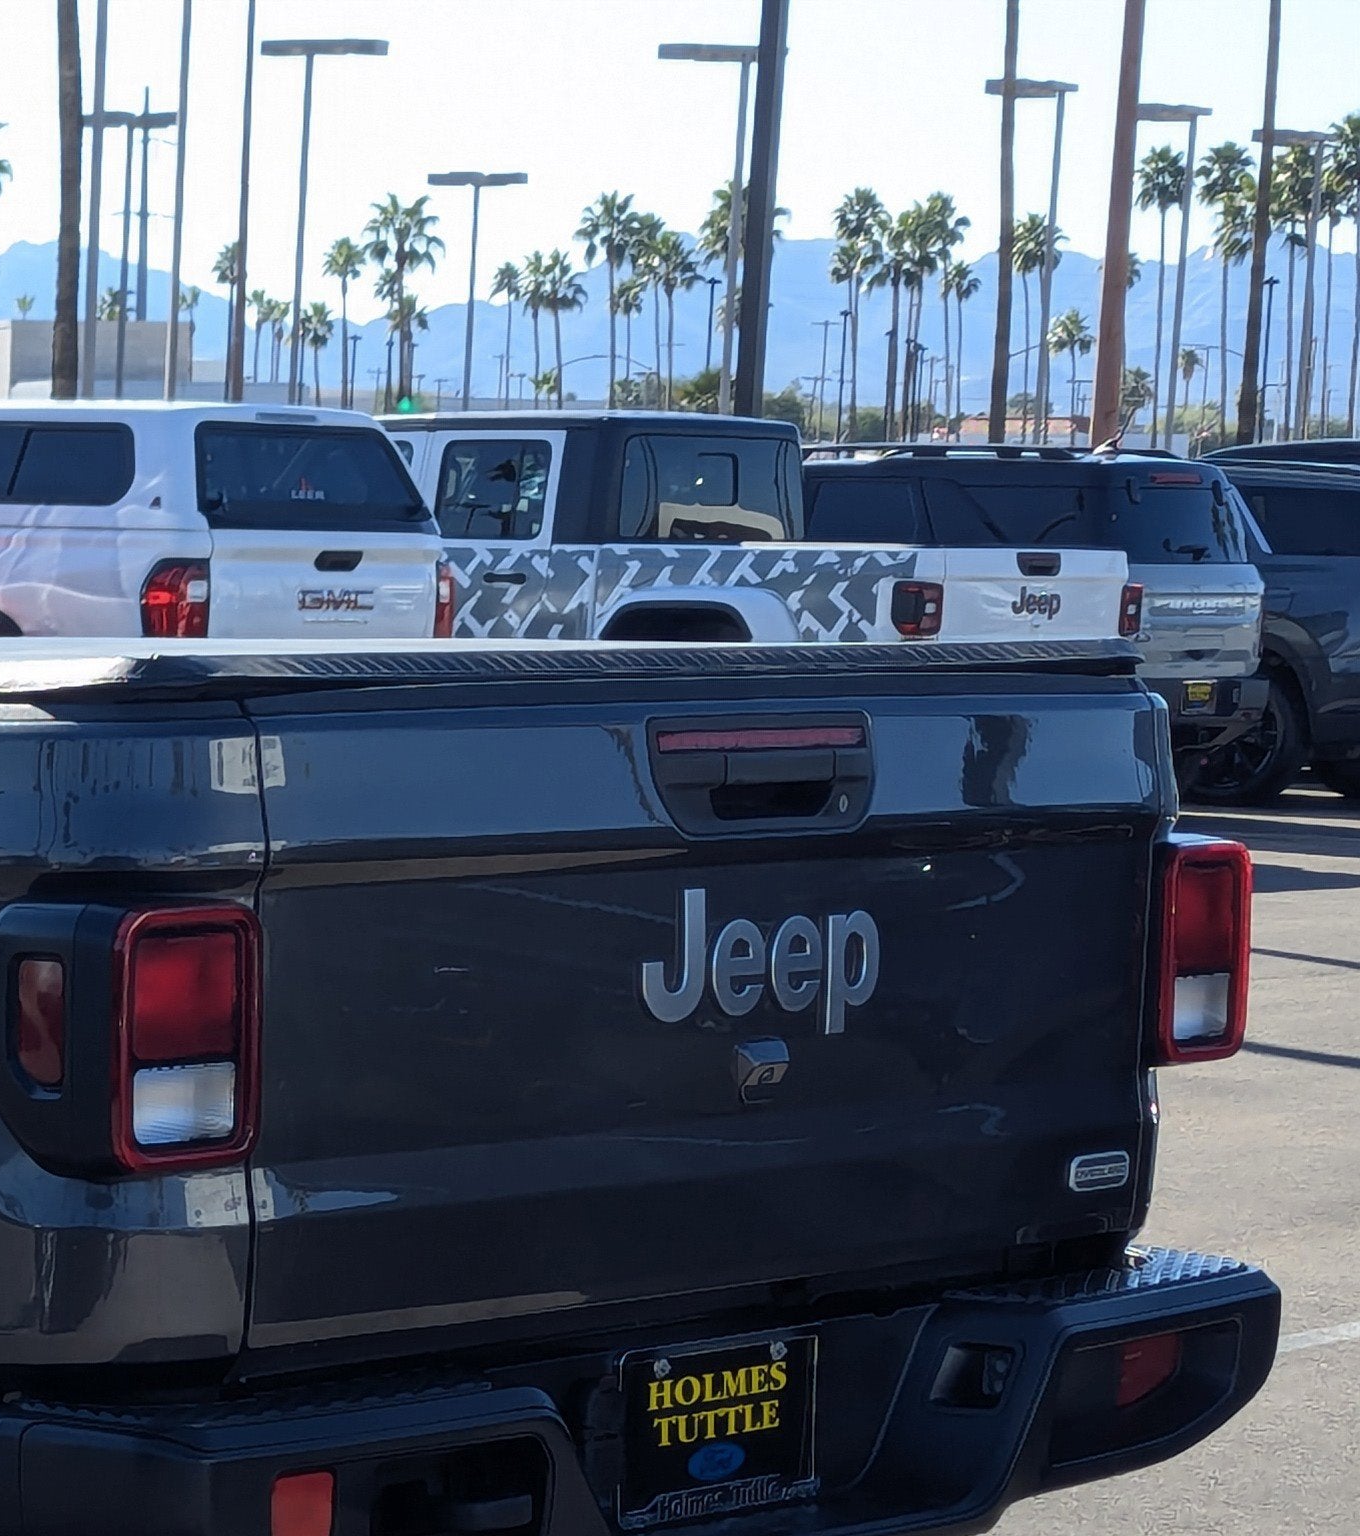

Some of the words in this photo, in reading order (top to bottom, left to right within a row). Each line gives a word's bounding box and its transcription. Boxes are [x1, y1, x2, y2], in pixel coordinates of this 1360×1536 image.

[297, 588, 376, 611] GMC
[1010, 585, 1062, 621] Jeep
[642, 888, 880, 1035] Jeep
[646, 1361, 788, 1412] HOLMES
[652, 1399, 781, 1447] TUTTLE
